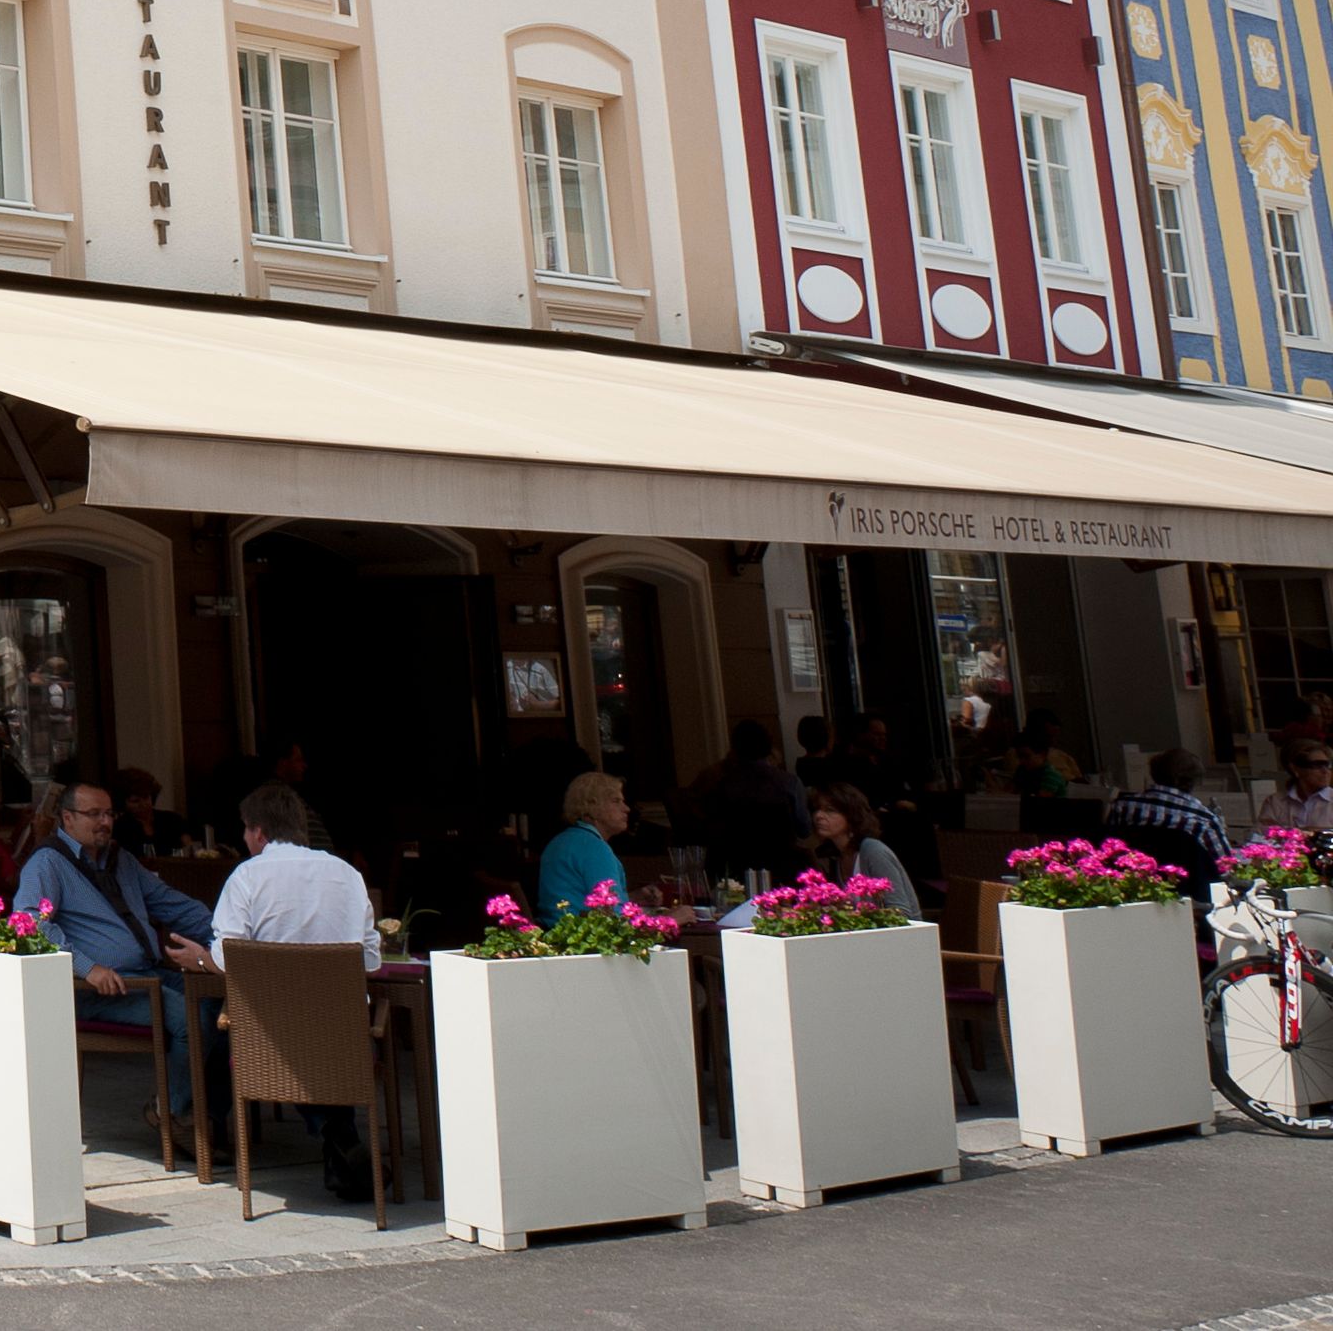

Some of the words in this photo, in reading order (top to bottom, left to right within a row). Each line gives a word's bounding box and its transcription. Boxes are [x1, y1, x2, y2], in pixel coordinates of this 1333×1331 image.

[850, 507, 884, 534] IRIS
[890, 510, 976, 538] PORSCHE
[993, 516, 1050, 543] HOTEL
[1054, 520, 1066, 544] &
[1070, 521, 1172, 550] RESTAURANT
[1247, 1099, 1333, 1130] CAMP
